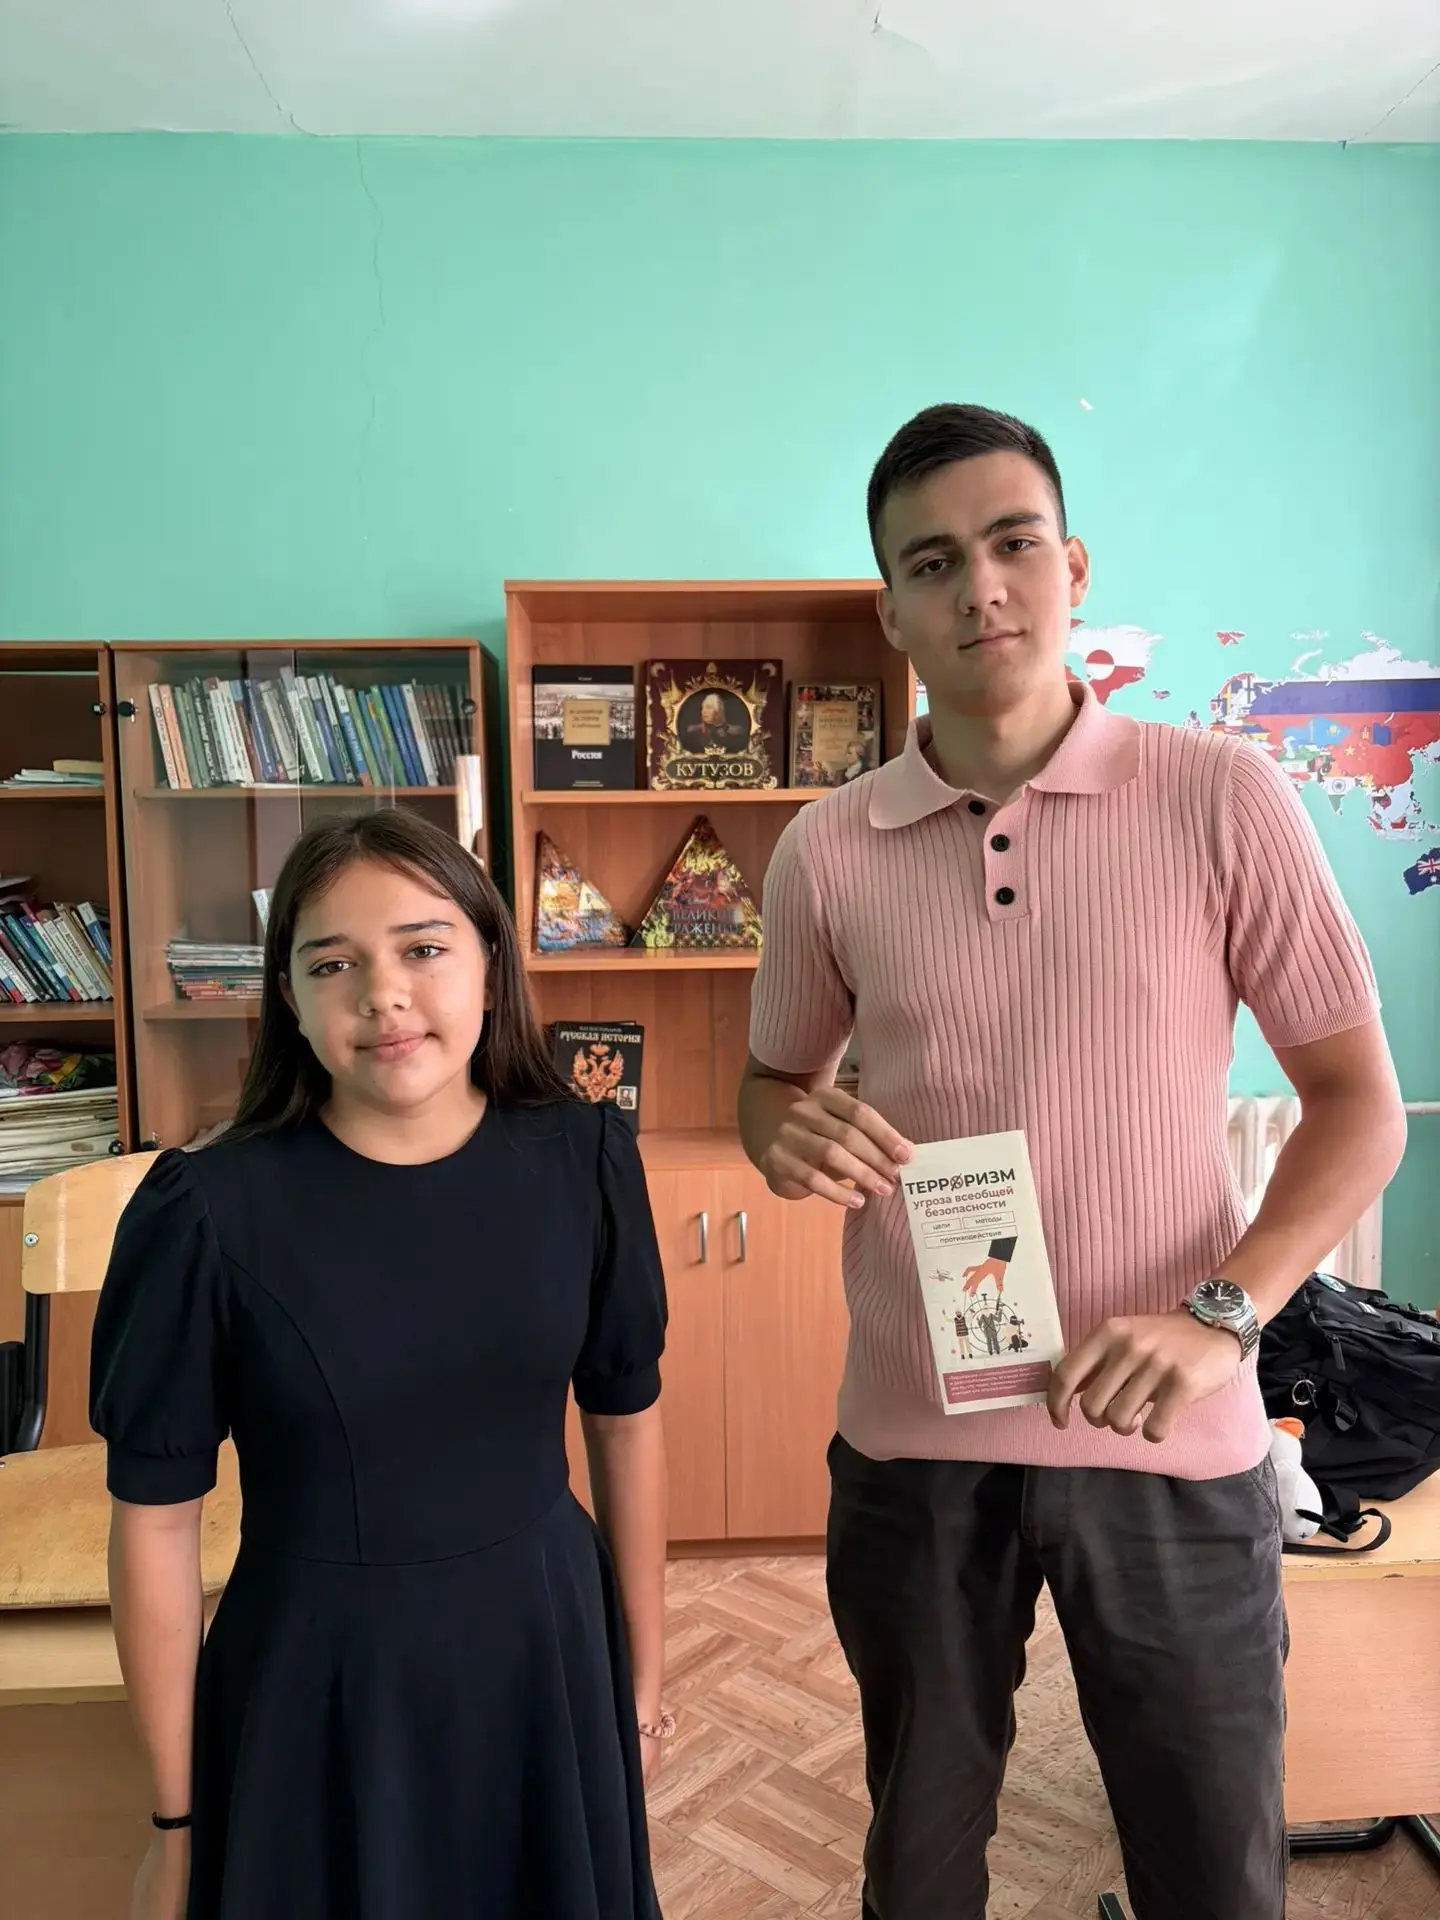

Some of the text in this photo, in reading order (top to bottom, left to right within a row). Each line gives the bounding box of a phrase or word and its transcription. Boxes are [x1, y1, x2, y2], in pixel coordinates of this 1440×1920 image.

[676, 763, 754, 777] КУТУЗОВ
[601, 1032, 642, 1044] ИСТОРИЯ
[905, 1168, 1016, 1195] ТЕРРОРИЗМ
[913, 1186, 1014, 1210] угроза всеобщей
[925, 1200, 1007, 1218] безопасности
[932, 1222, 951, 1231] цели
[975, 1216, 1003, 1225] методы
